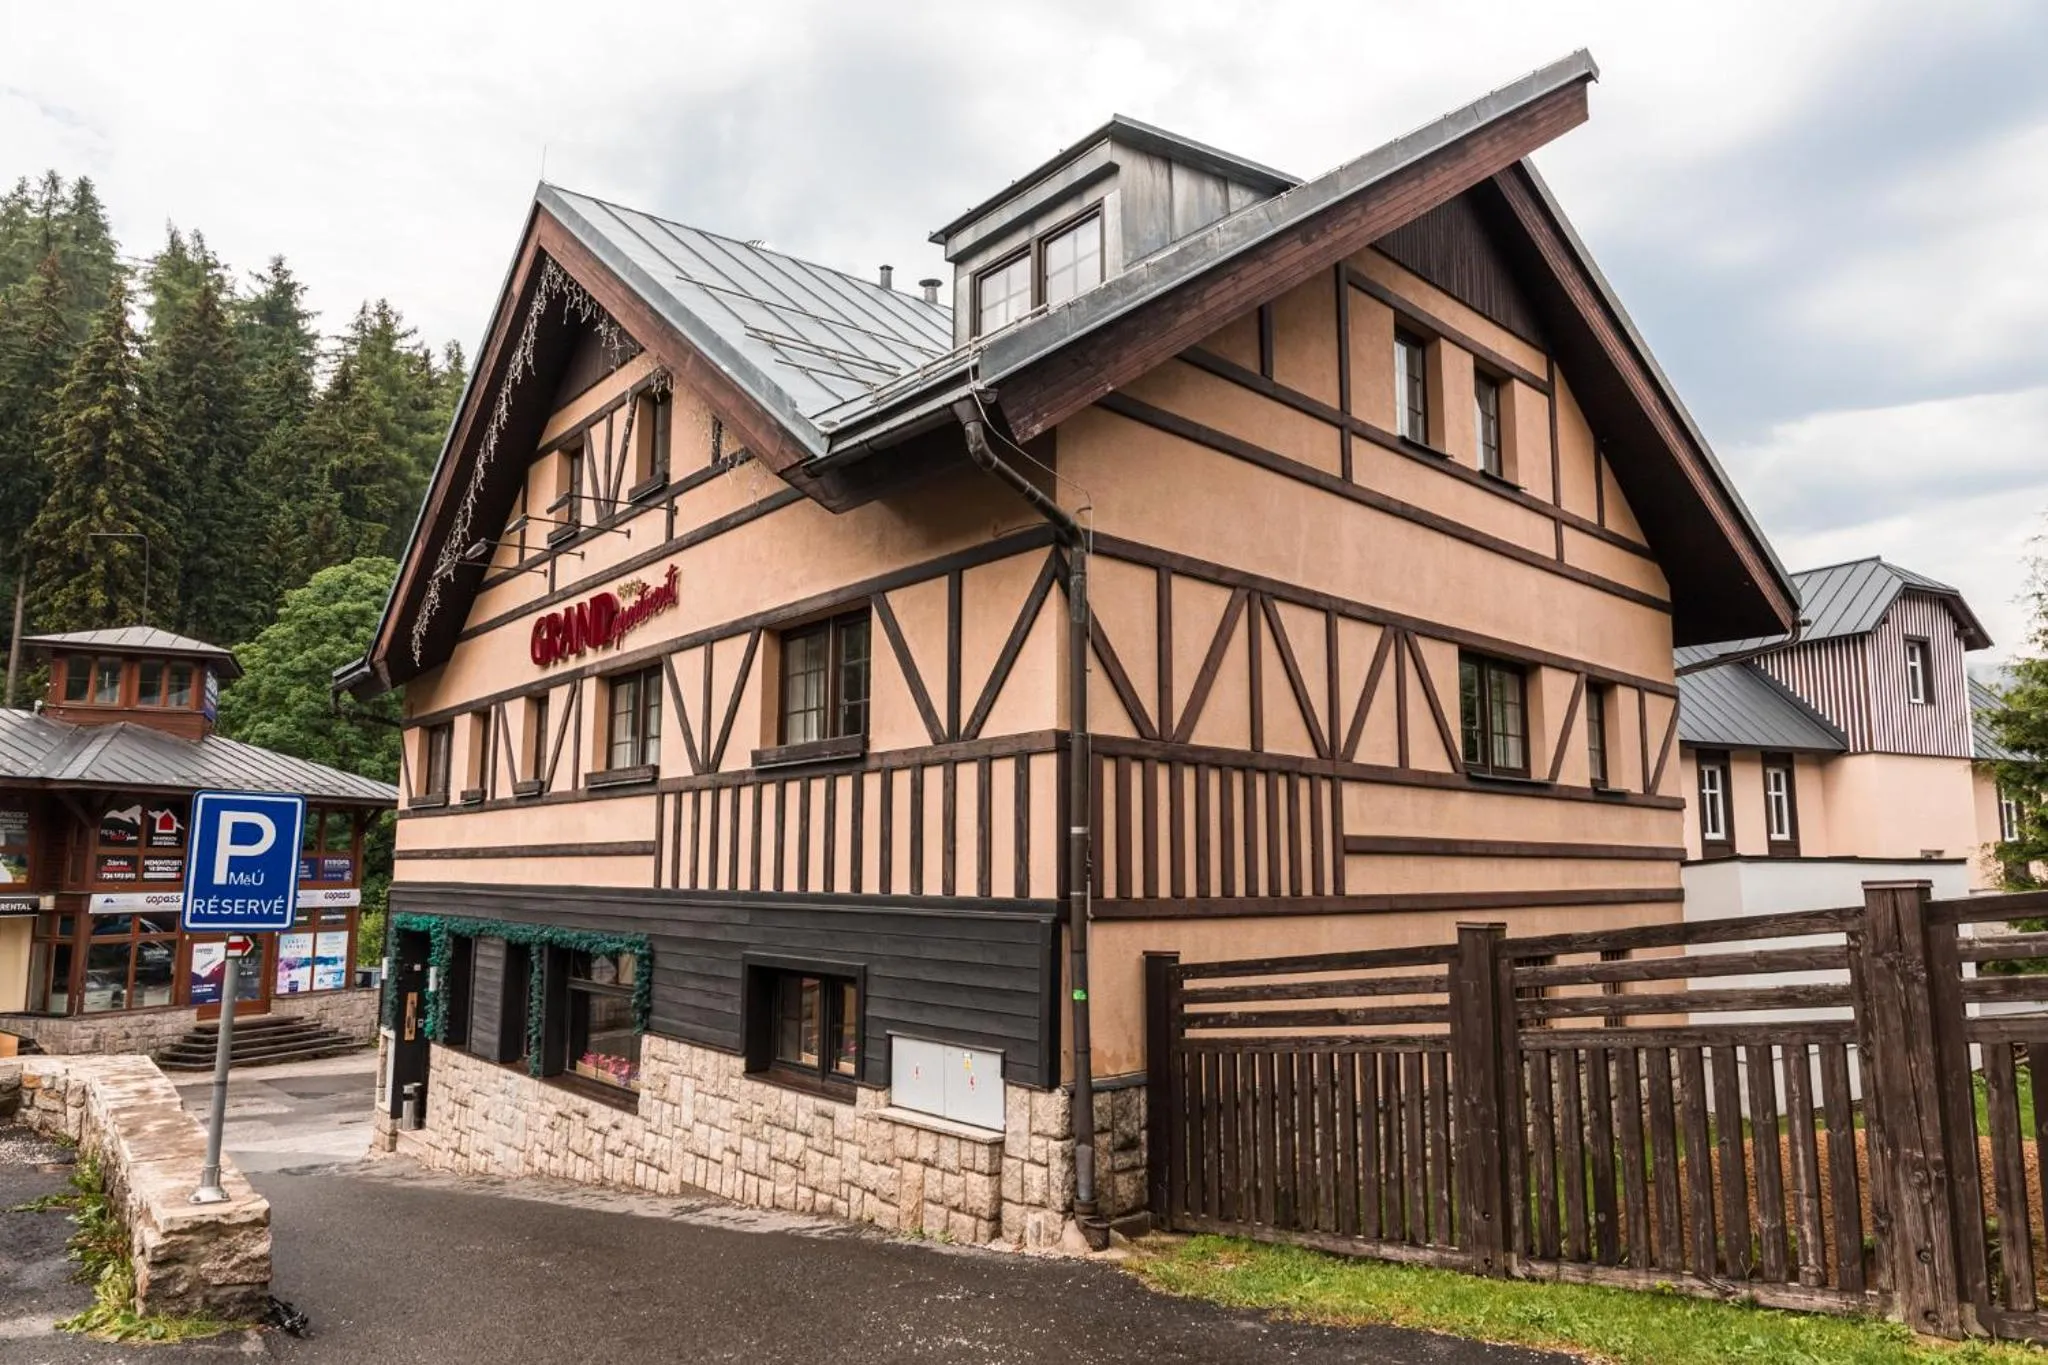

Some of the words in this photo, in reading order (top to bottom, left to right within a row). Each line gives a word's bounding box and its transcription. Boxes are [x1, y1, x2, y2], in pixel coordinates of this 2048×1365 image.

[530, 592, 620, 666] GRAND
[213, 810, 276, 885] P
[192, 894, 285, 915] RÉSERVÉ
